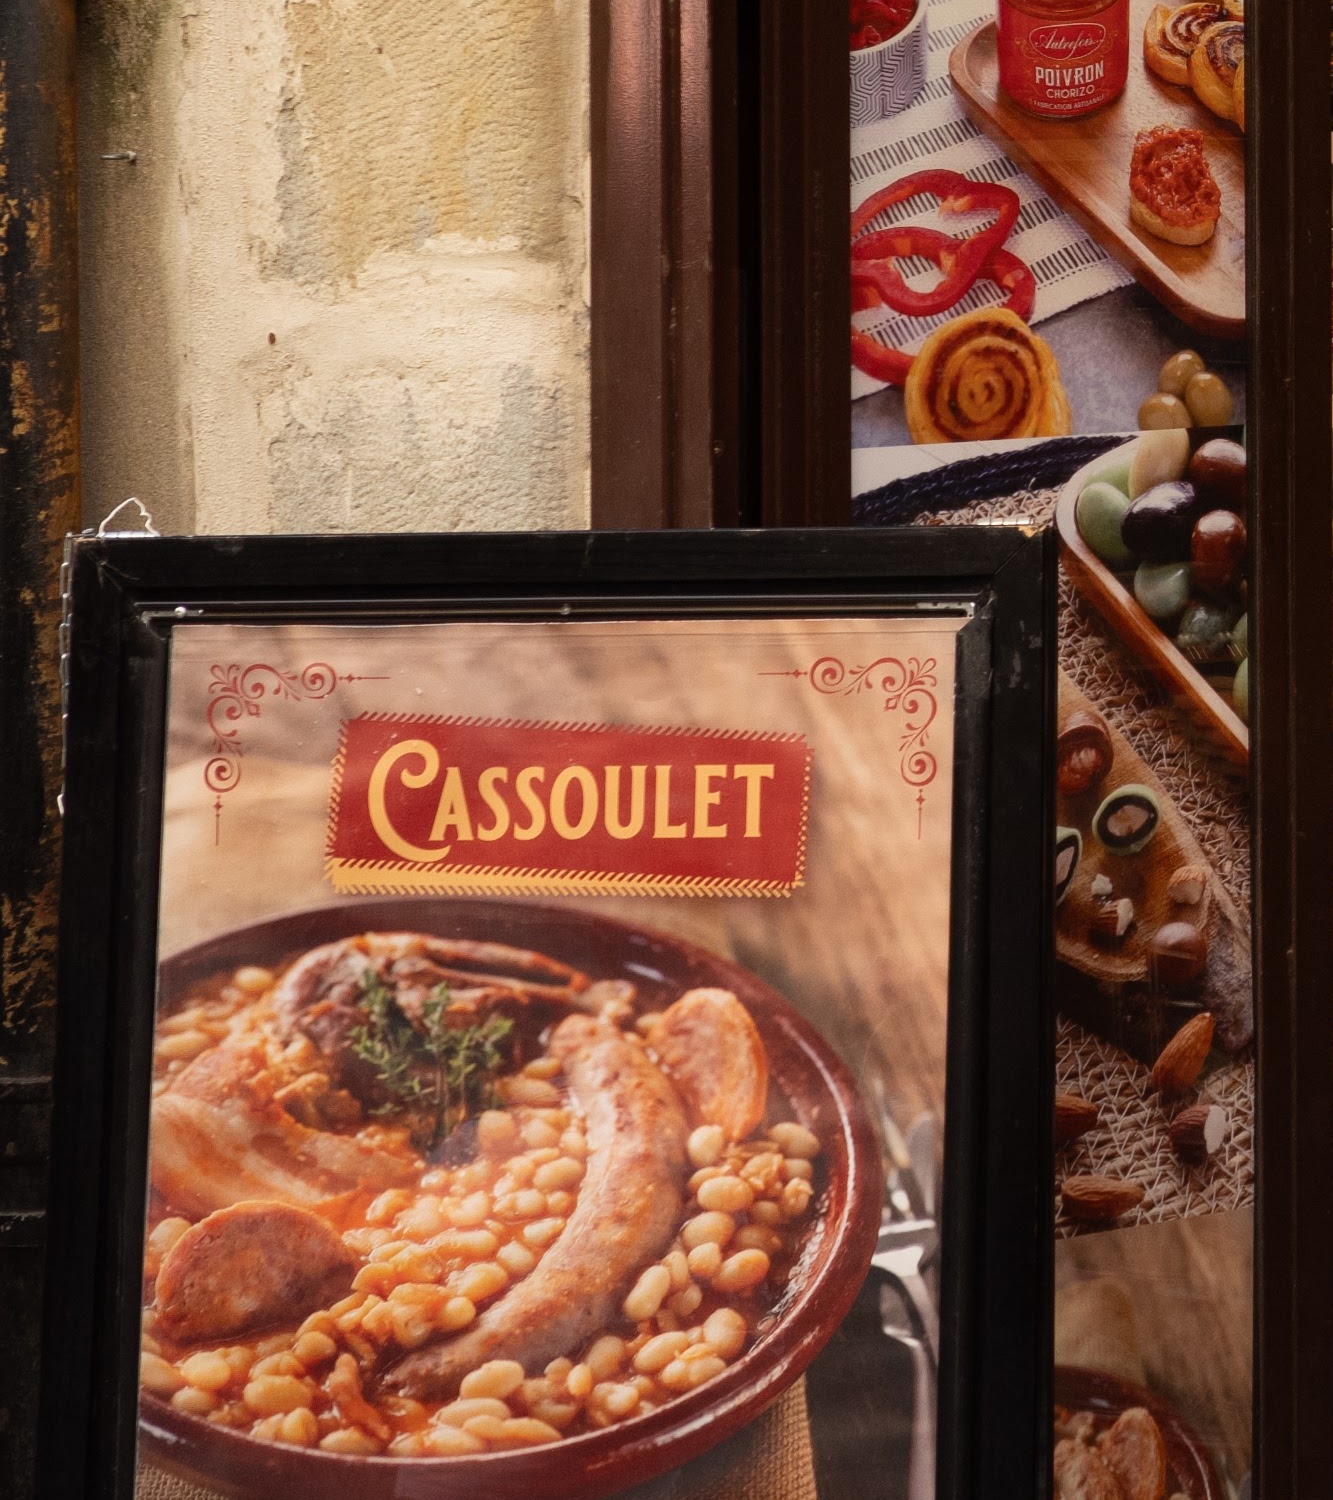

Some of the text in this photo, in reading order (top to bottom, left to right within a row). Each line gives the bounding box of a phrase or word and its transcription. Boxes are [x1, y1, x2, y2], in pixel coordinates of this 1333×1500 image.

[1034, 64, 1105, 85] POIVRON
[1045, 86, 1096, 98] CHORIZO
[367, 738, 775, 862] CASSOULET
